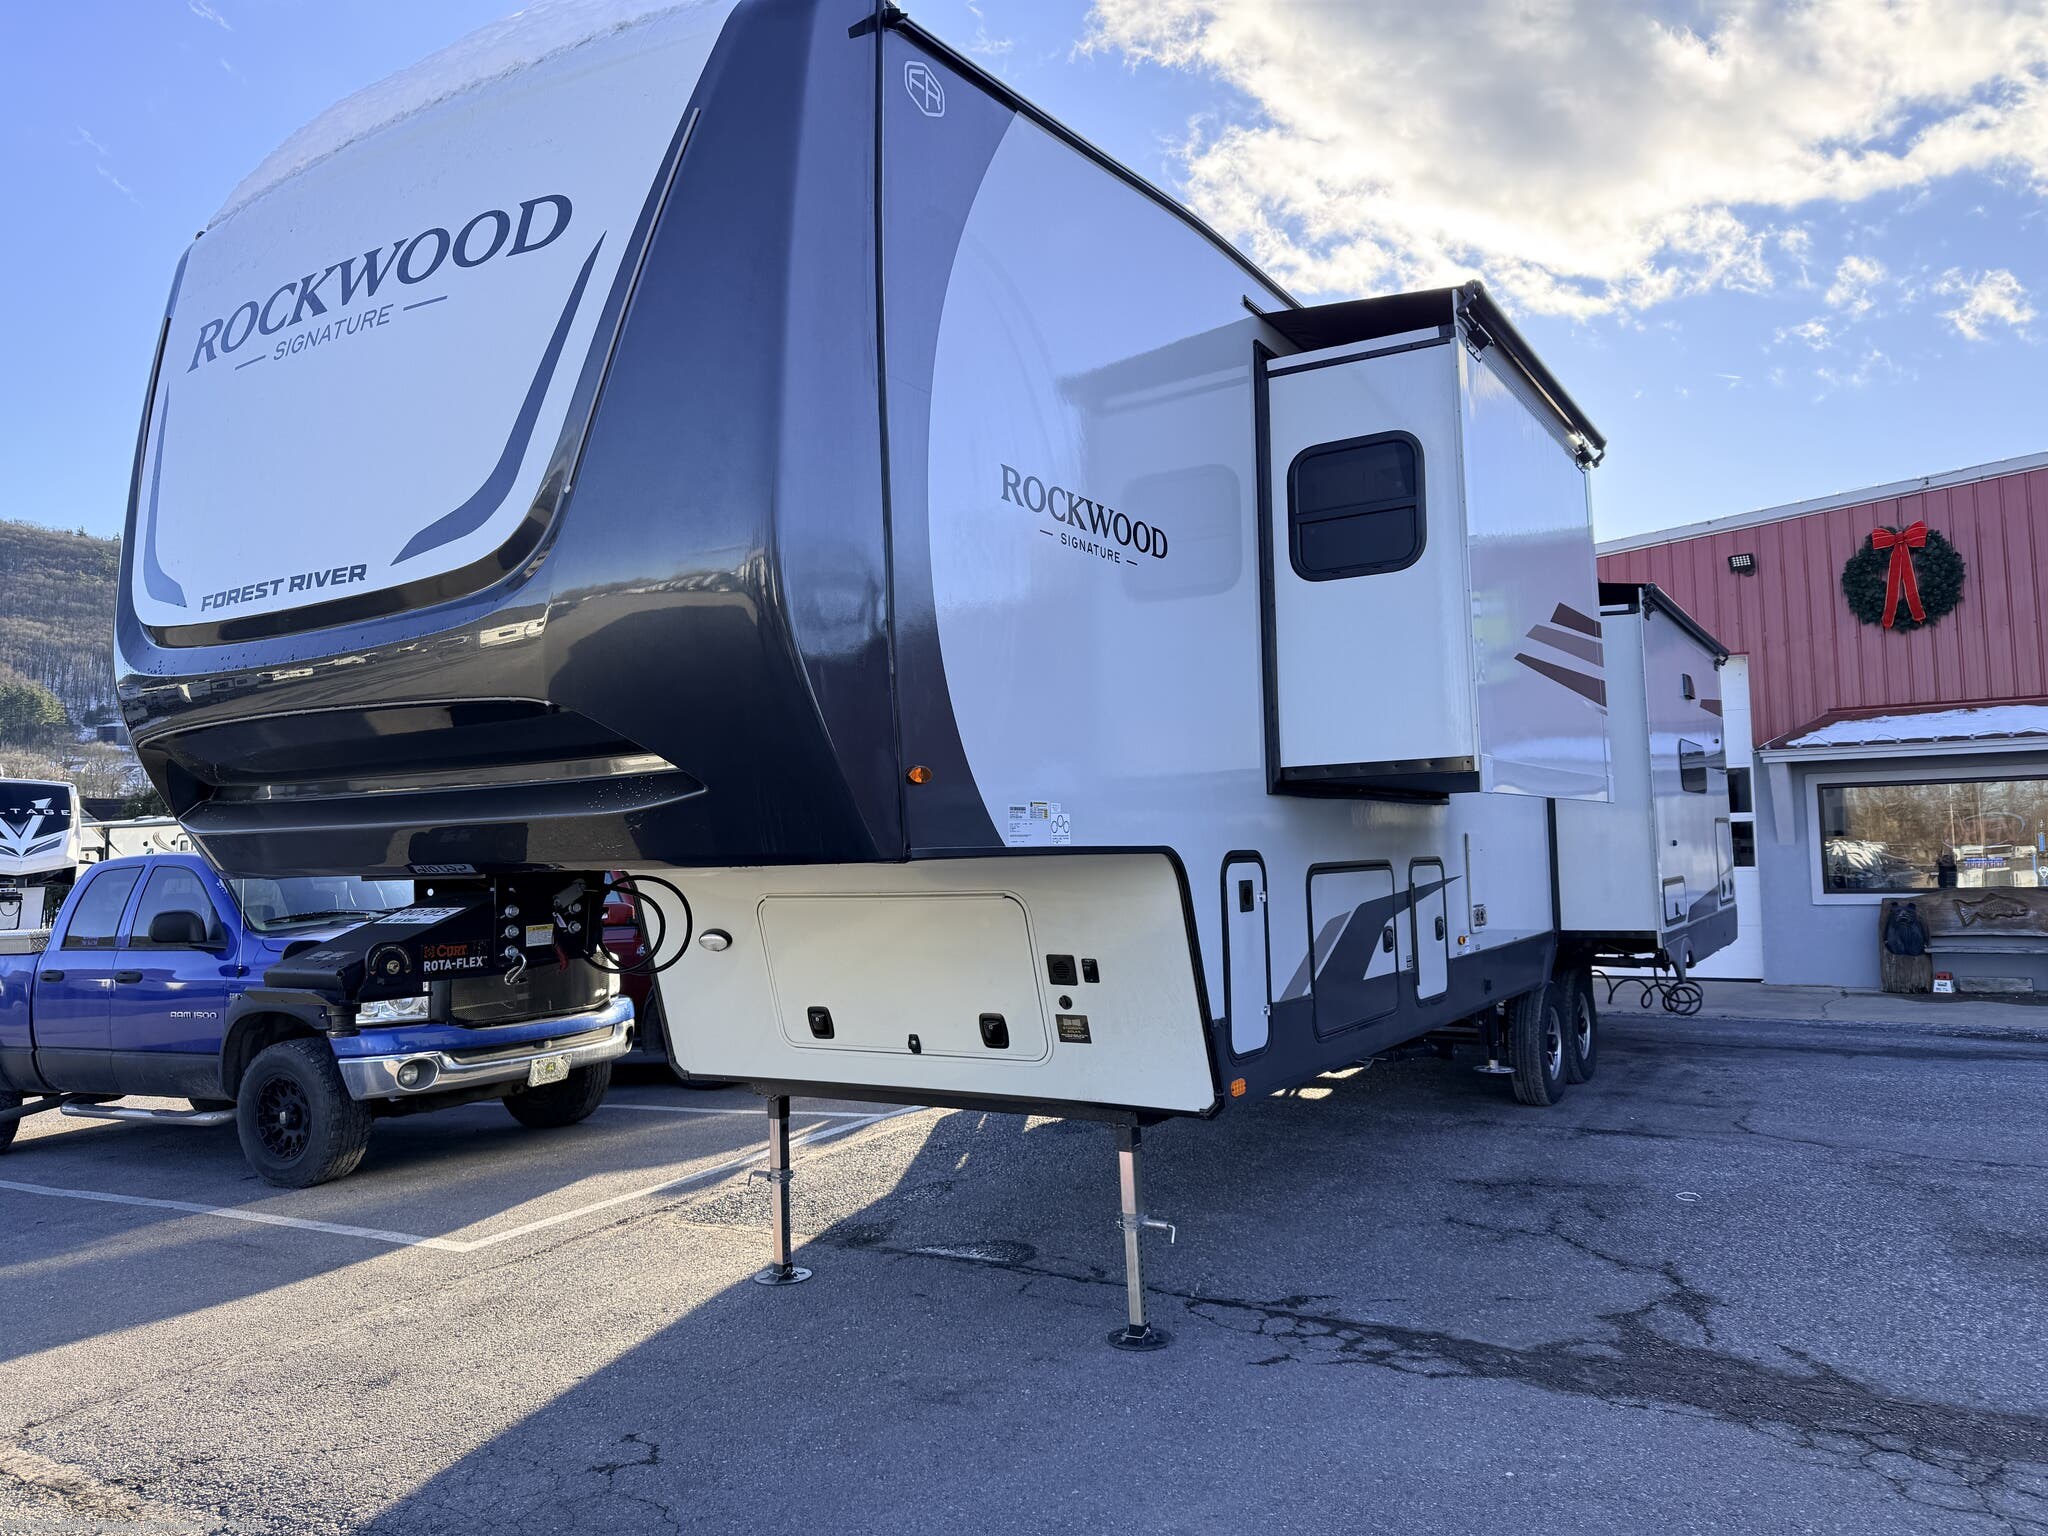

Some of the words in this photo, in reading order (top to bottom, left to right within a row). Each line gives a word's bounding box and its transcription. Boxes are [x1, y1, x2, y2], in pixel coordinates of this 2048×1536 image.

[186, 193, 573, 374] ROCKWOOD
[273, 303, 394, 361] SIGNATURE
[1000, 463, 1169, 560] ROCKWOOD
[1060, 532, 1121, 564] SIGNATURE
[200, 577, 285, 612] FOREST
[288, 564, 367, 592] RIVER
[423, 956, 483, 972] ROTA-FLEX
[436, 944, 468, 957] CURT
[193, 1011, 217, 1019] 1500
